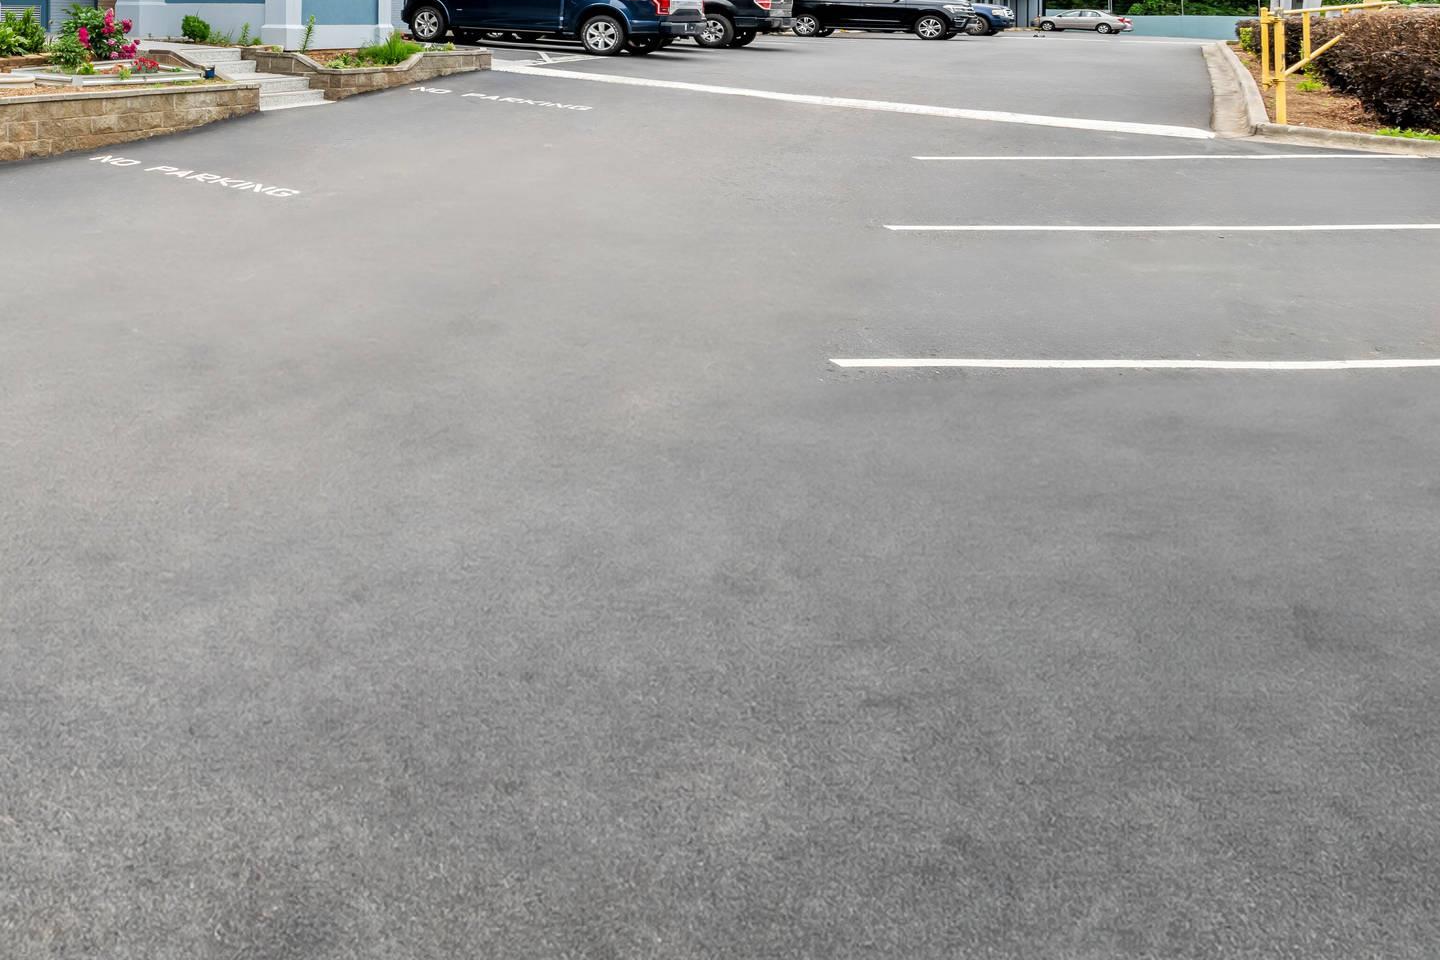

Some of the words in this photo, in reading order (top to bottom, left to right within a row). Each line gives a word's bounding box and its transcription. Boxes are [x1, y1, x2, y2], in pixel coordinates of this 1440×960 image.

[409, 86, 453, 94] NO
[461, 92, 593, 111] PARKING
[89, 155, 142, 166] NO
[144, 165, 301, 197] PARKING
